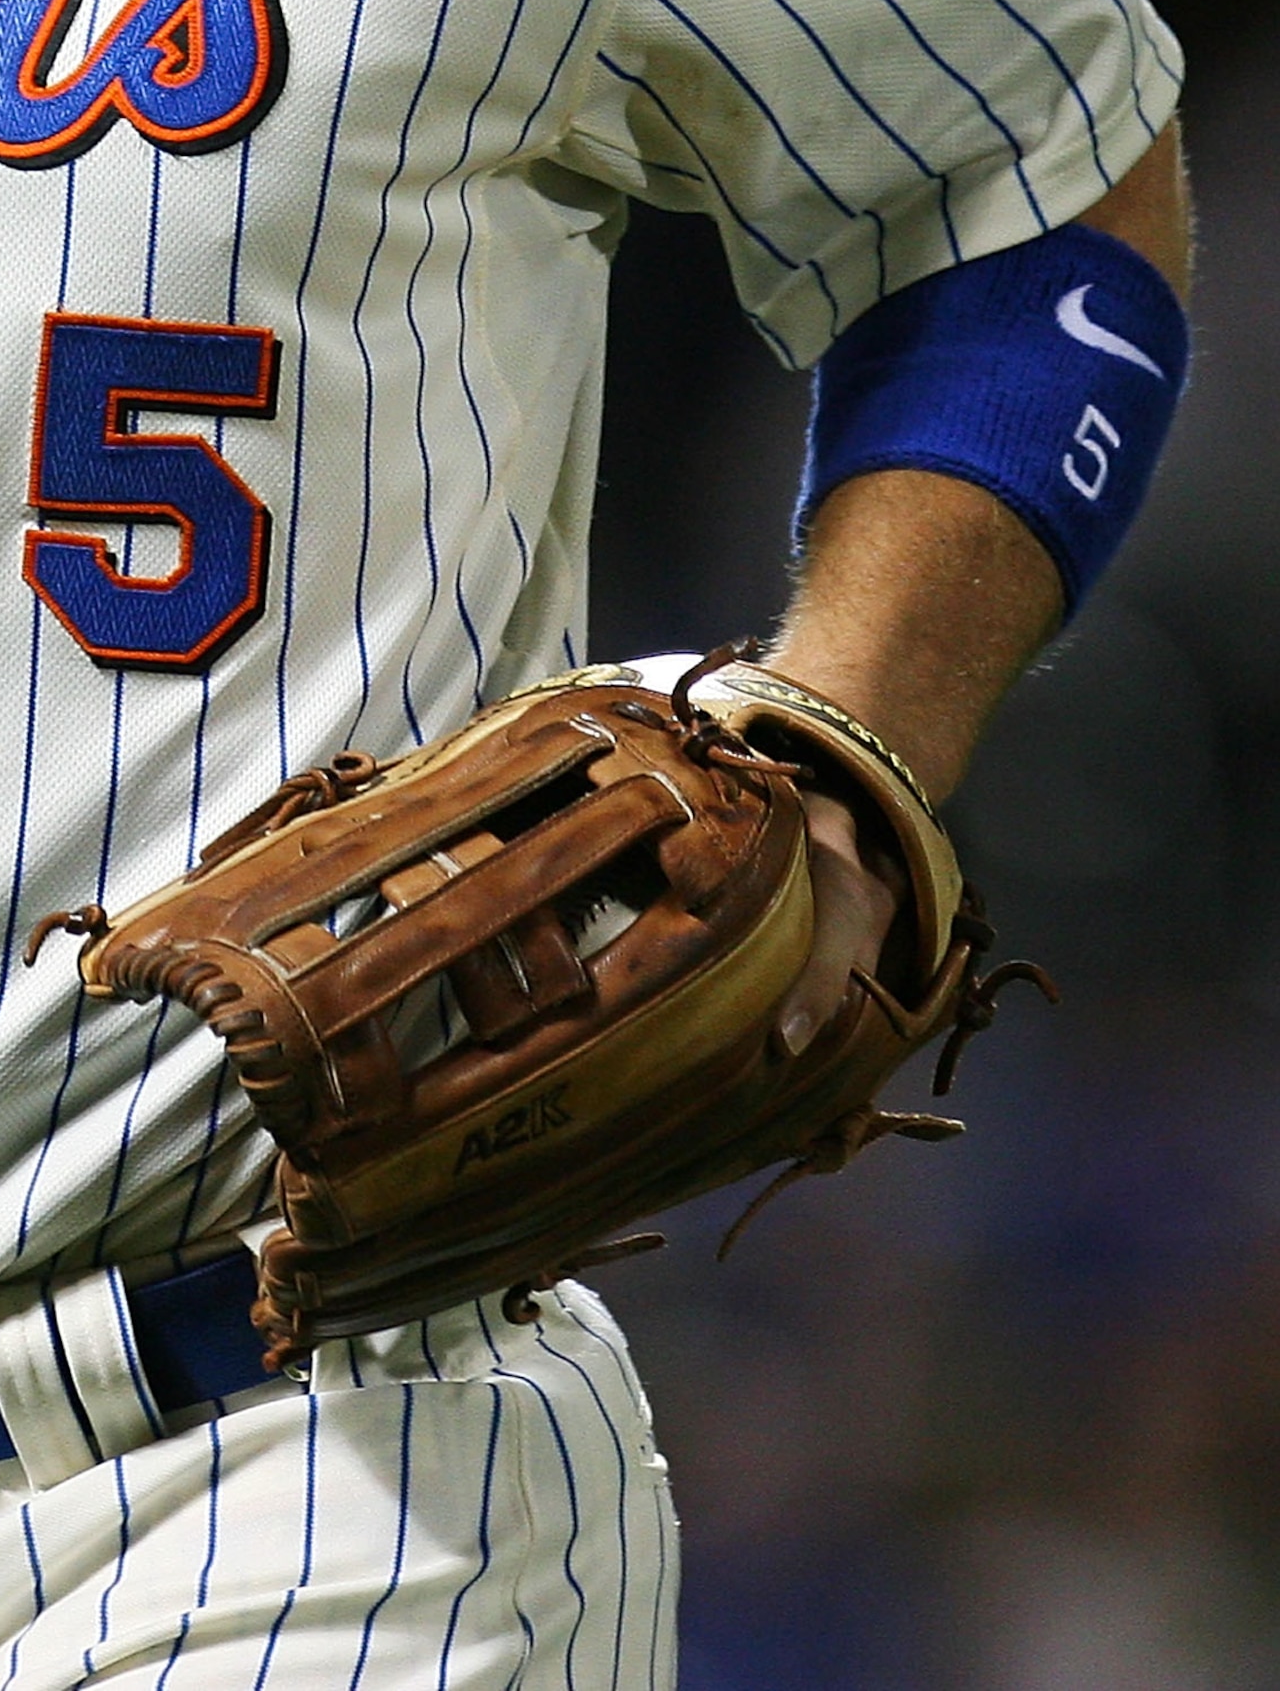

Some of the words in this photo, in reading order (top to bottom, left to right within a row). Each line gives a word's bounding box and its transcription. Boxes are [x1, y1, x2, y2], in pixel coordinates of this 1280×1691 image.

[22, 312, 283, 675] 5
[1062, 404, 1120, 500] 5
[453, 1082, 573, 1177] A2K
